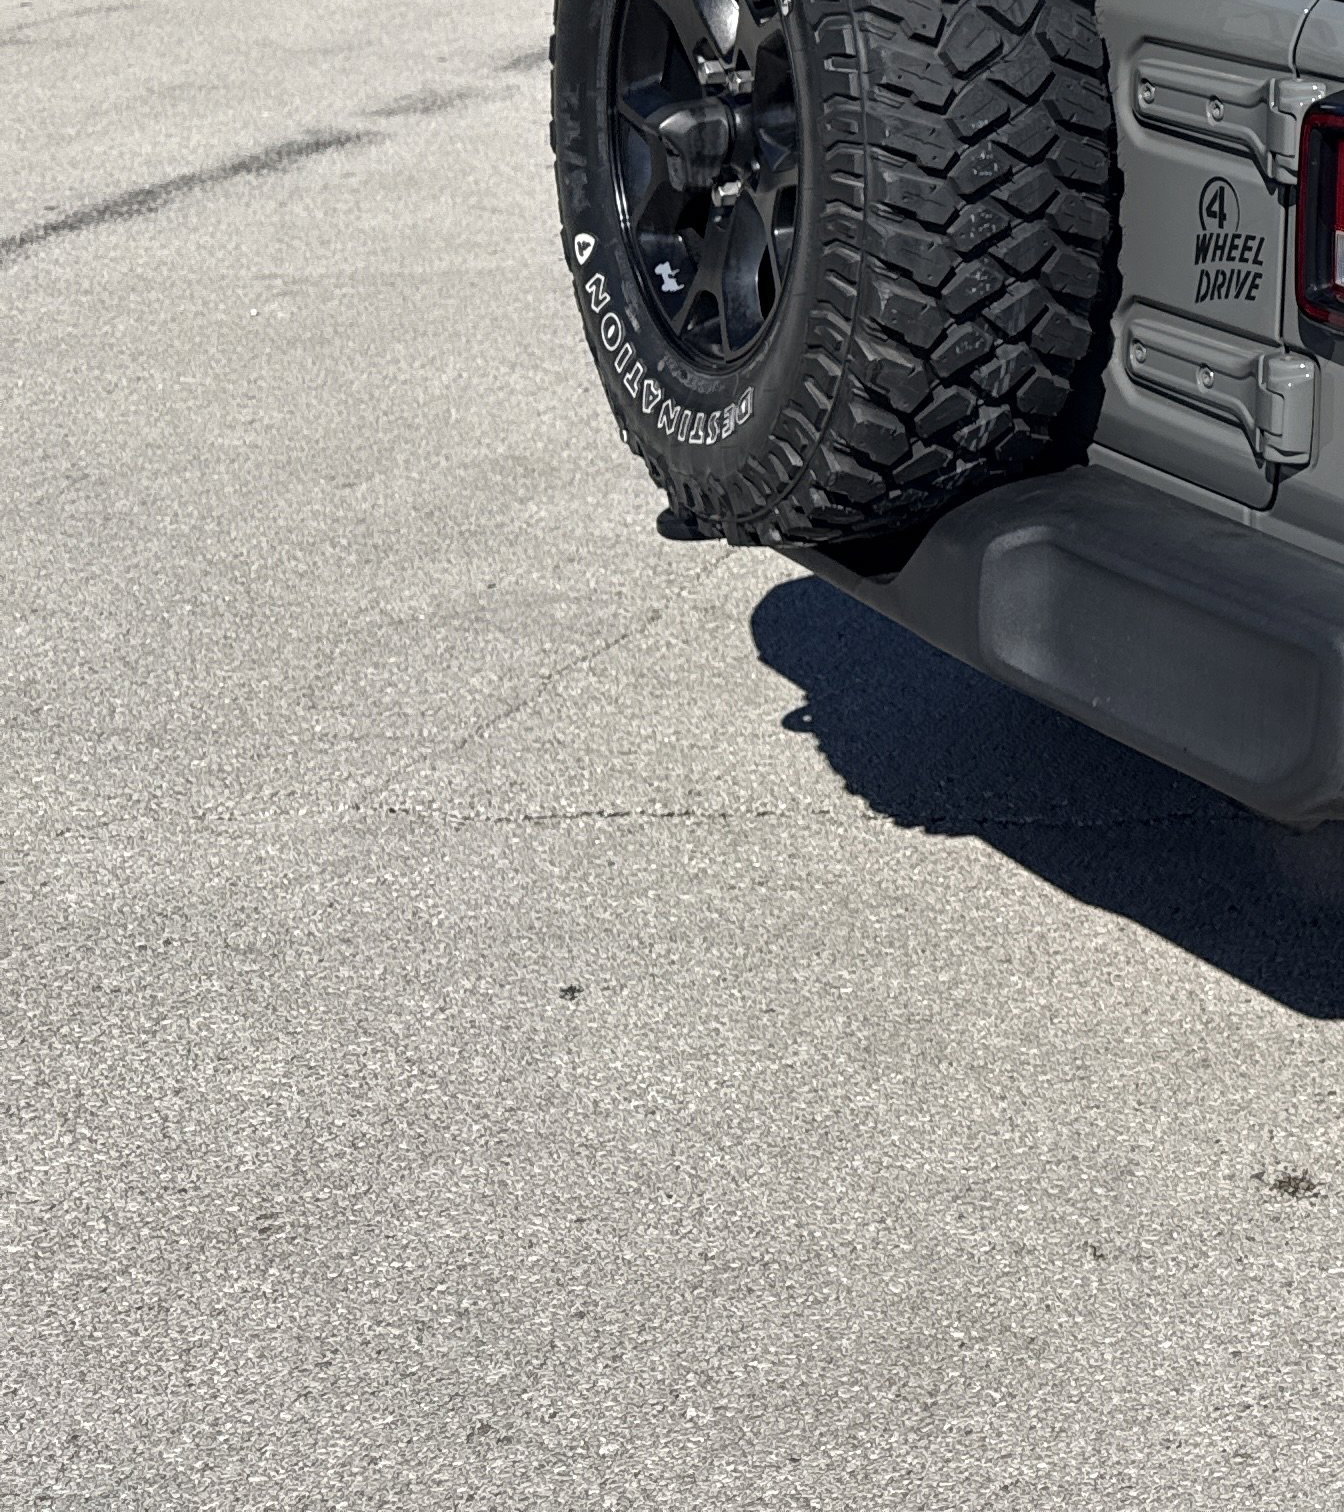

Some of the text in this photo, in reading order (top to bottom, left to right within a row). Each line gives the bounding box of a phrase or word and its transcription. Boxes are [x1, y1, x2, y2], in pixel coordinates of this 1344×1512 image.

[1206, 186, 1227, 229] 4
[1194, 232, 1265, 266] WHEEL
[1194, 269, 1263, 304] DRIVE
[585, 273, 755, 445] DESTINATION
